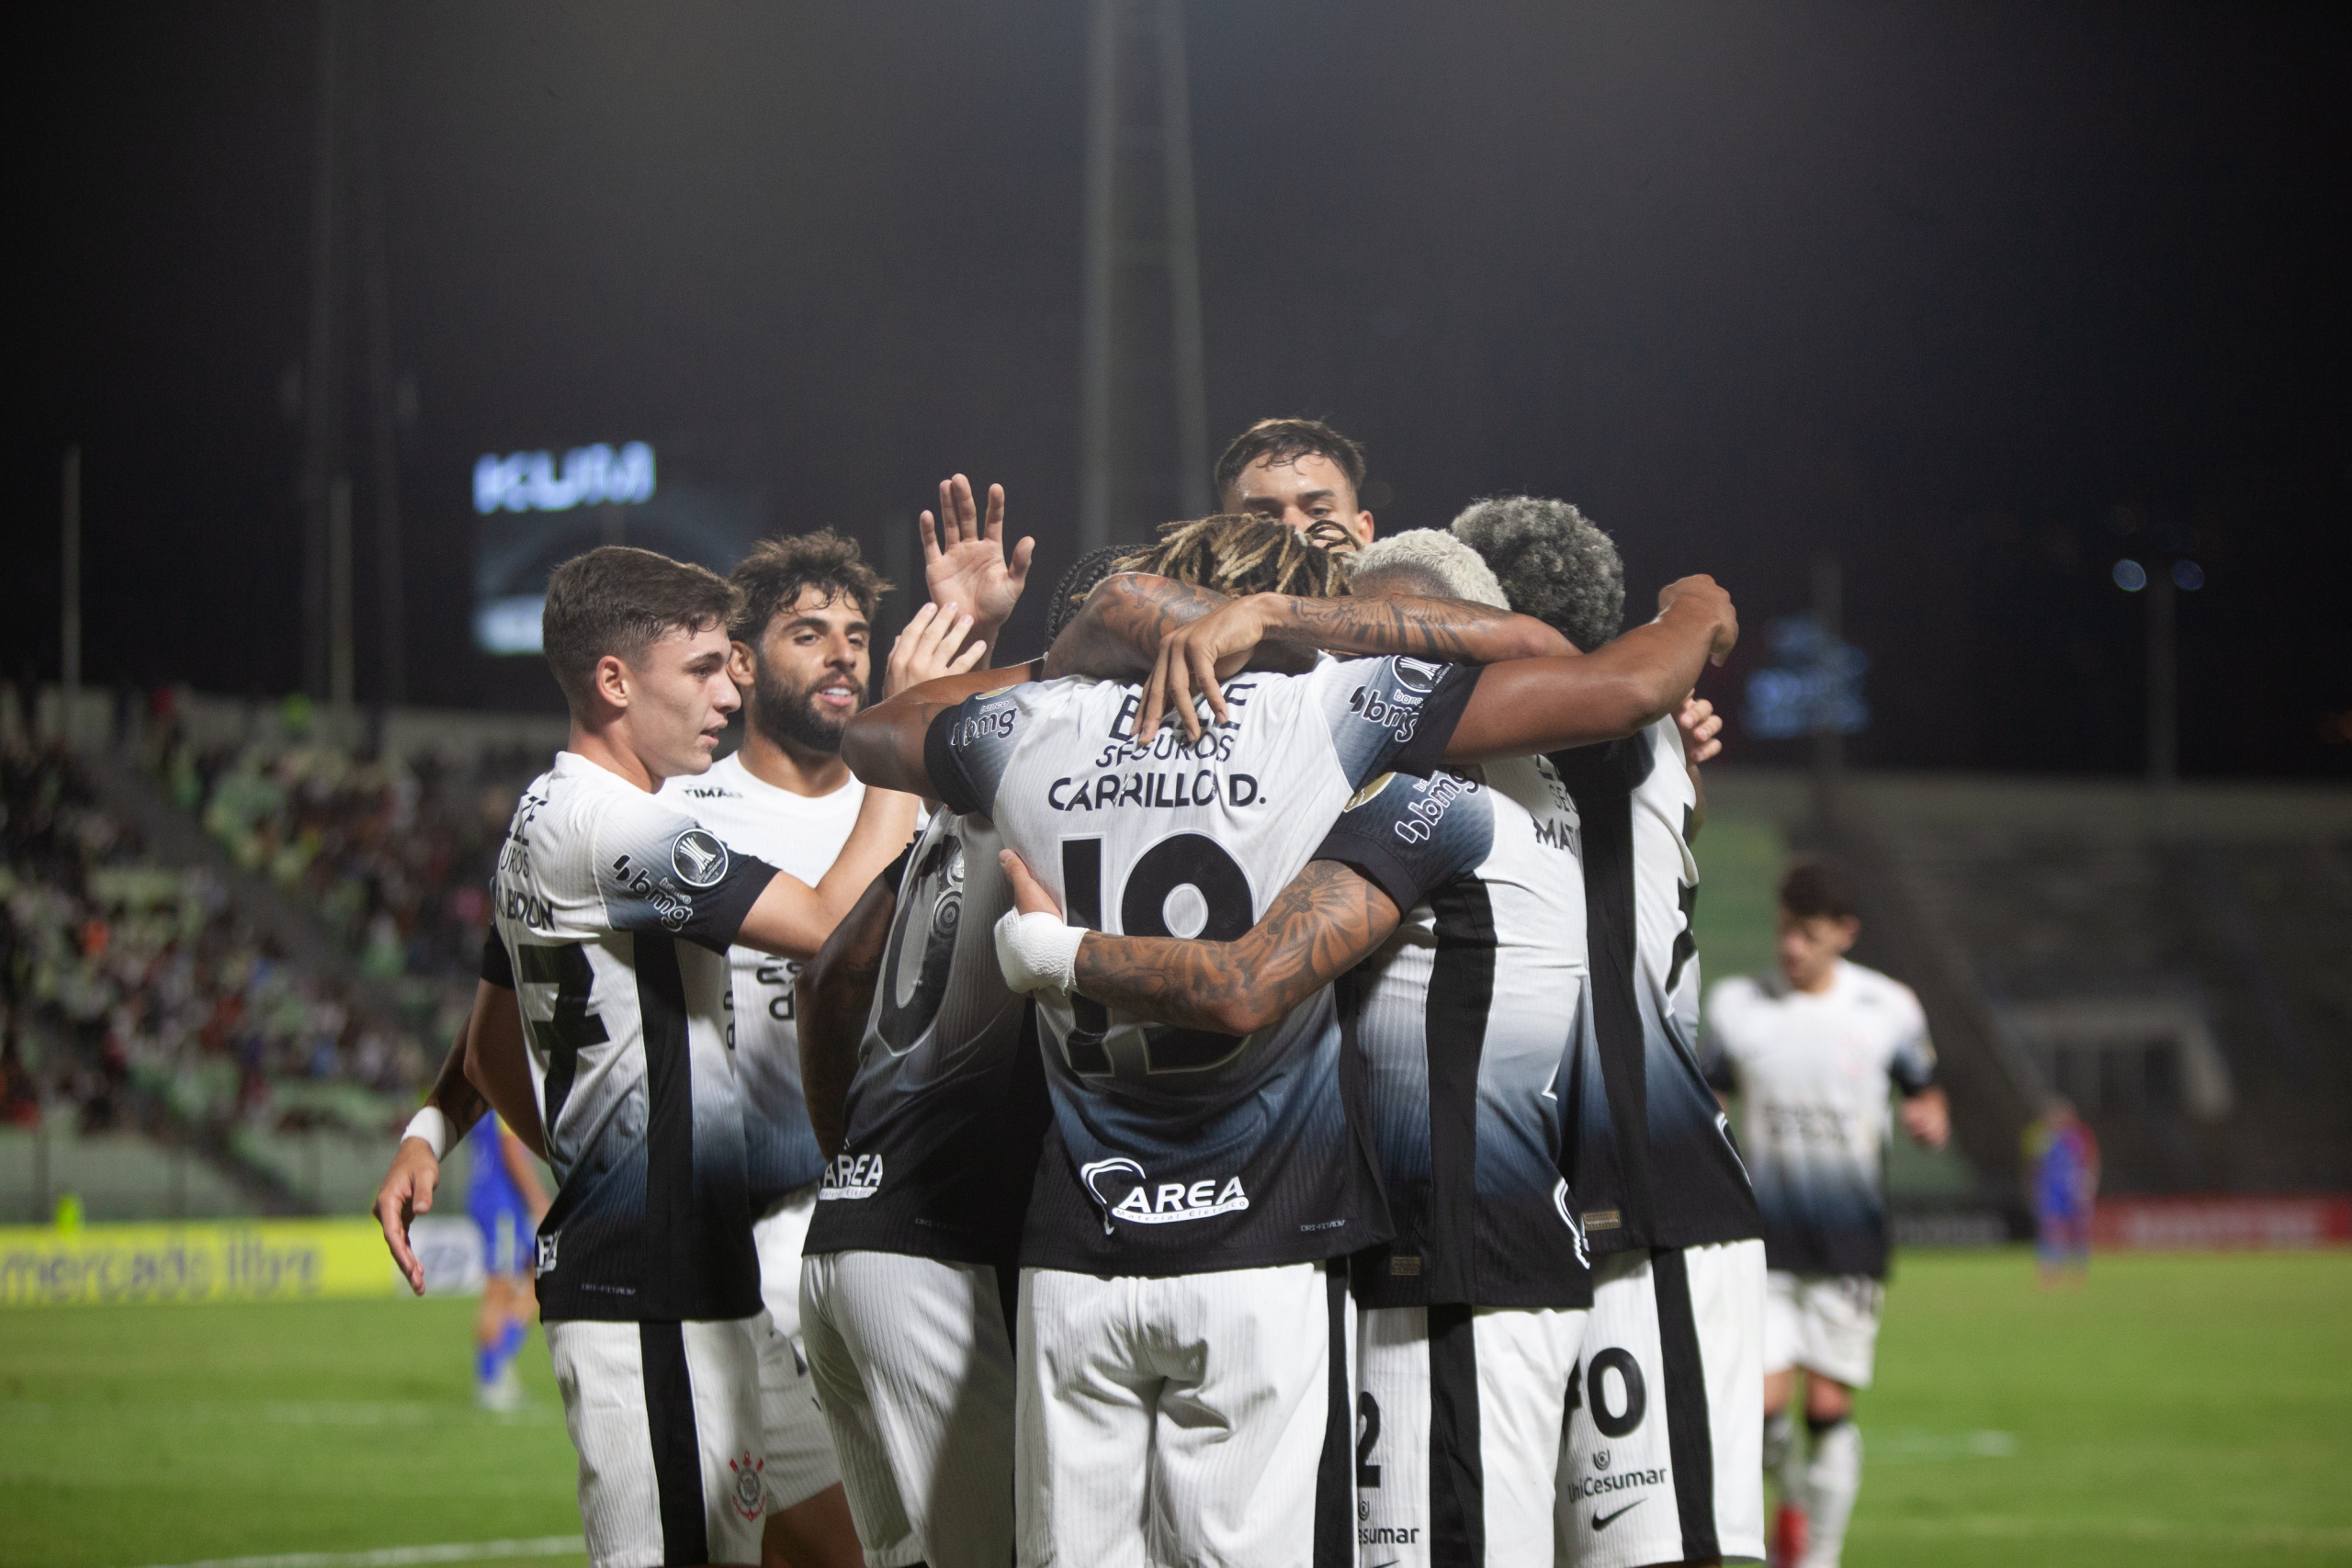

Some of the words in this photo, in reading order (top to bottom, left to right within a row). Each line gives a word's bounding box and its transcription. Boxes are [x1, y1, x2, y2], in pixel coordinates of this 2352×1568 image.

[1048, 770, 1218, 811] CARRILLO
[1229, 773, 1267, 807] D.
[627, 868, 694, 932] bmg
[1060, 829, 1261, 1080] 19
[822, 1154, 884, 1188] AREA
[1117, 1176, 1246, 1213] AREA
